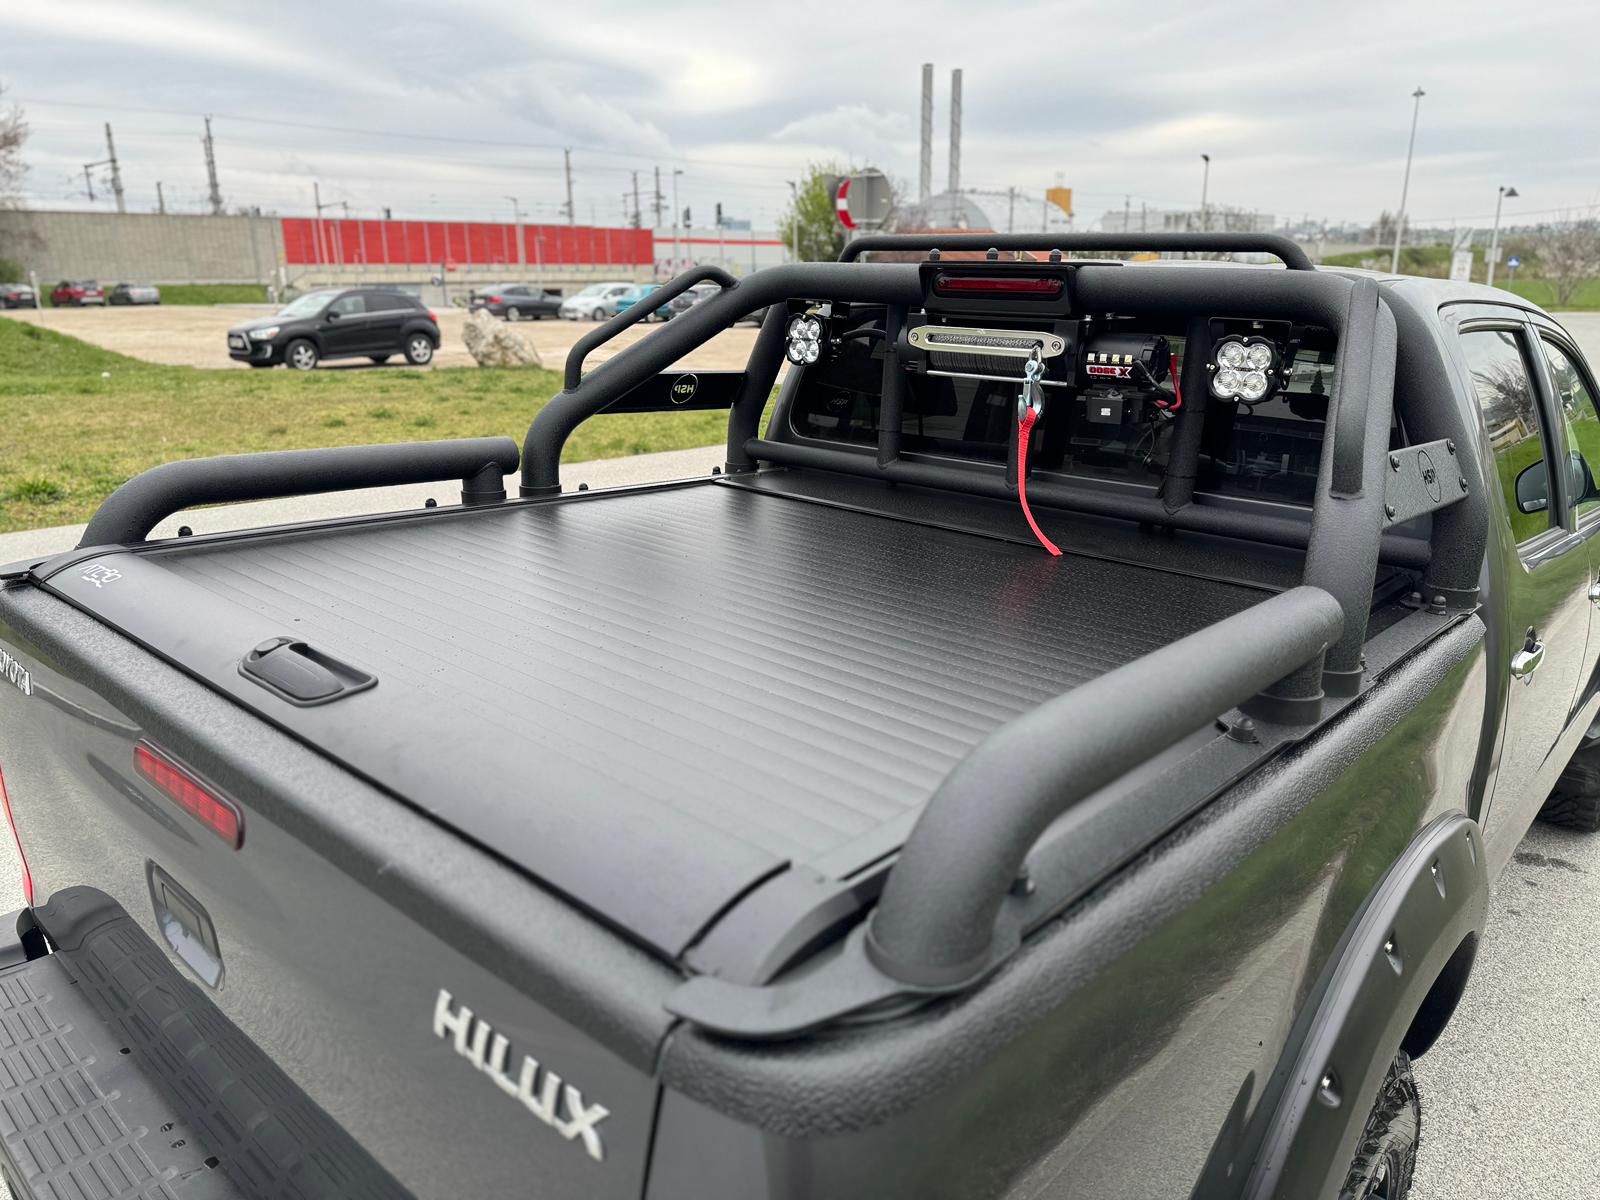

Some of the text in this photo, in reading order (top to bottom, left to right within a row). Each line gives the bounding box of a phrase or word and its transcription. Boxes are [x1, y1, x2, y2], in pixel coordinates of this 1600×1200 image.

[1422, 468, 1436, 486] HSP
[0, 648, 31, 696] OYOTA
[433, 988, 610, 1162] HILUX
